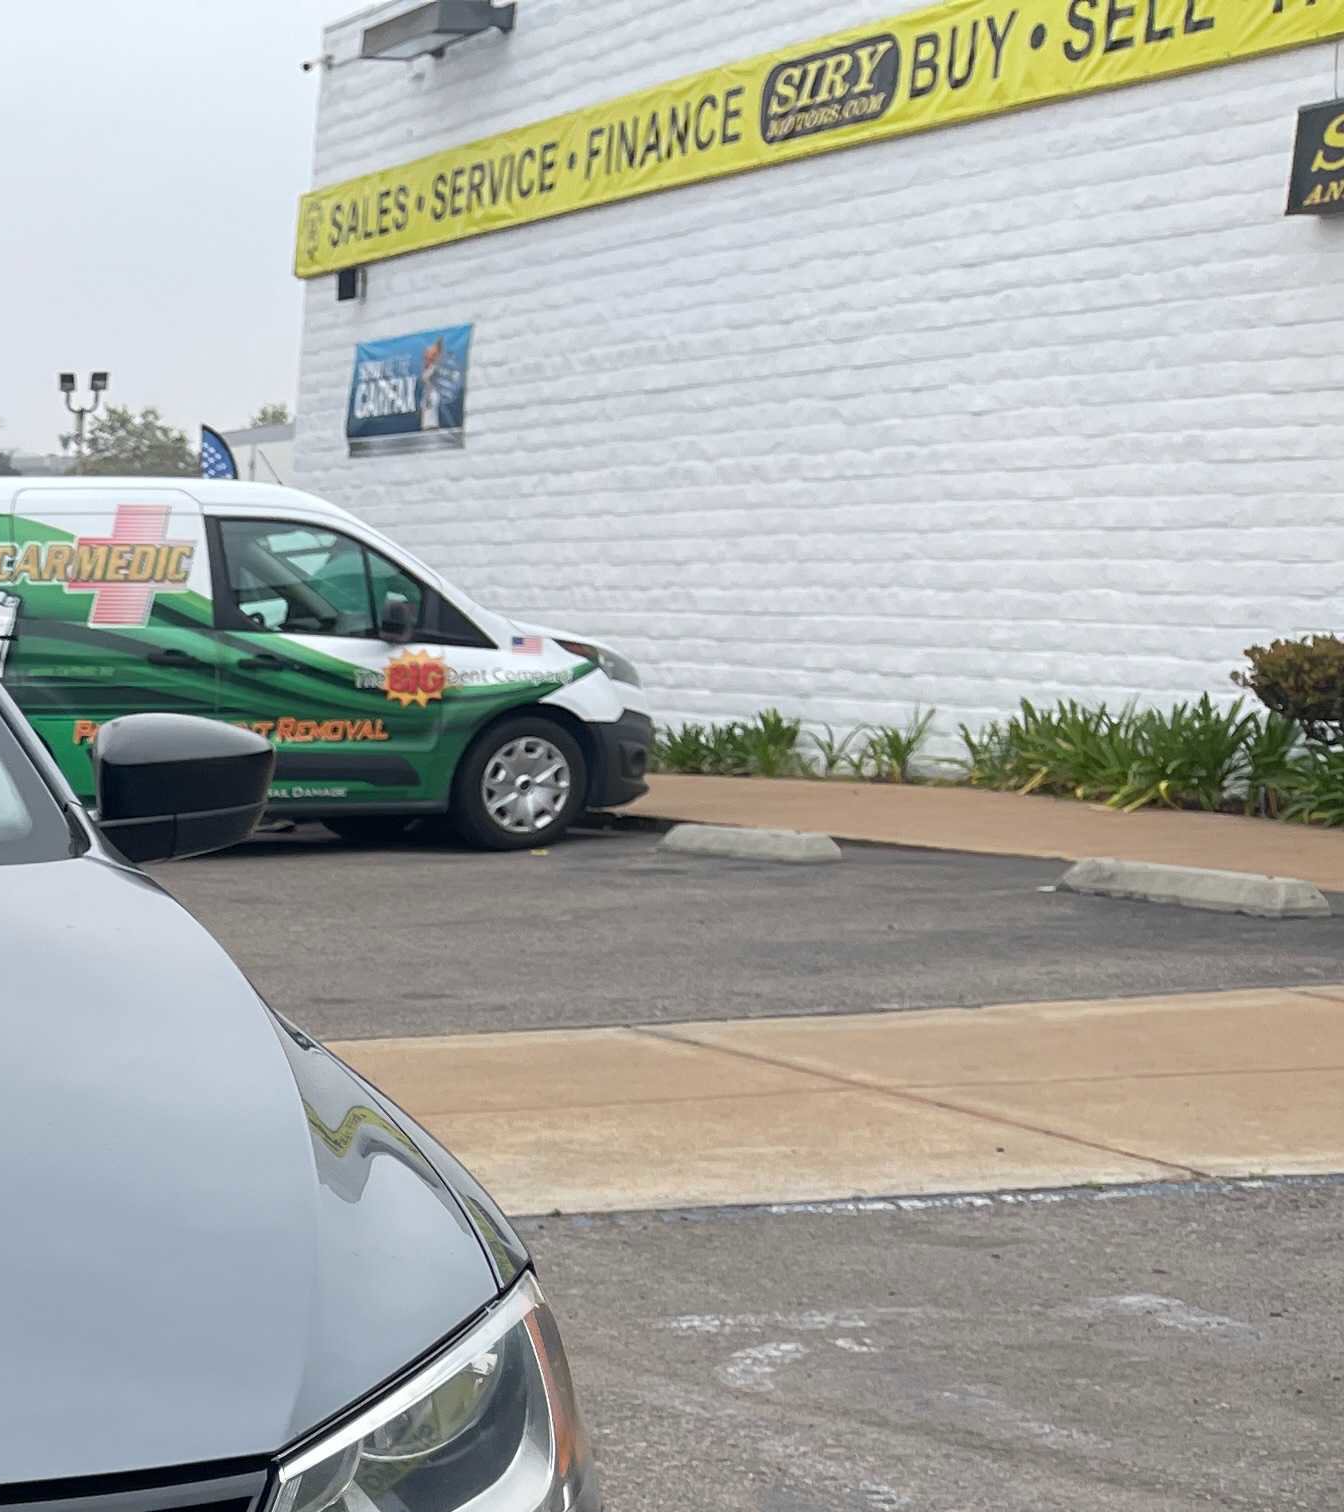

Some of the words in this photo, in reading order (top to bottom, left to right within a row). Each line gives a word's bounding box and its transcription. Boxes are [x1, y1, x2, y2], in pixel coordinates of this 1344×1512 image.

[768, 41, 892, 114] SIRY
[909, 12, 1015, 99] BUY
[327, 184, 409, 248] SALES
[431, 142, 560, 220] SERVICE
[584, 87, 746, 179] FINANCE
[389, 662, 446, 695] BIG
